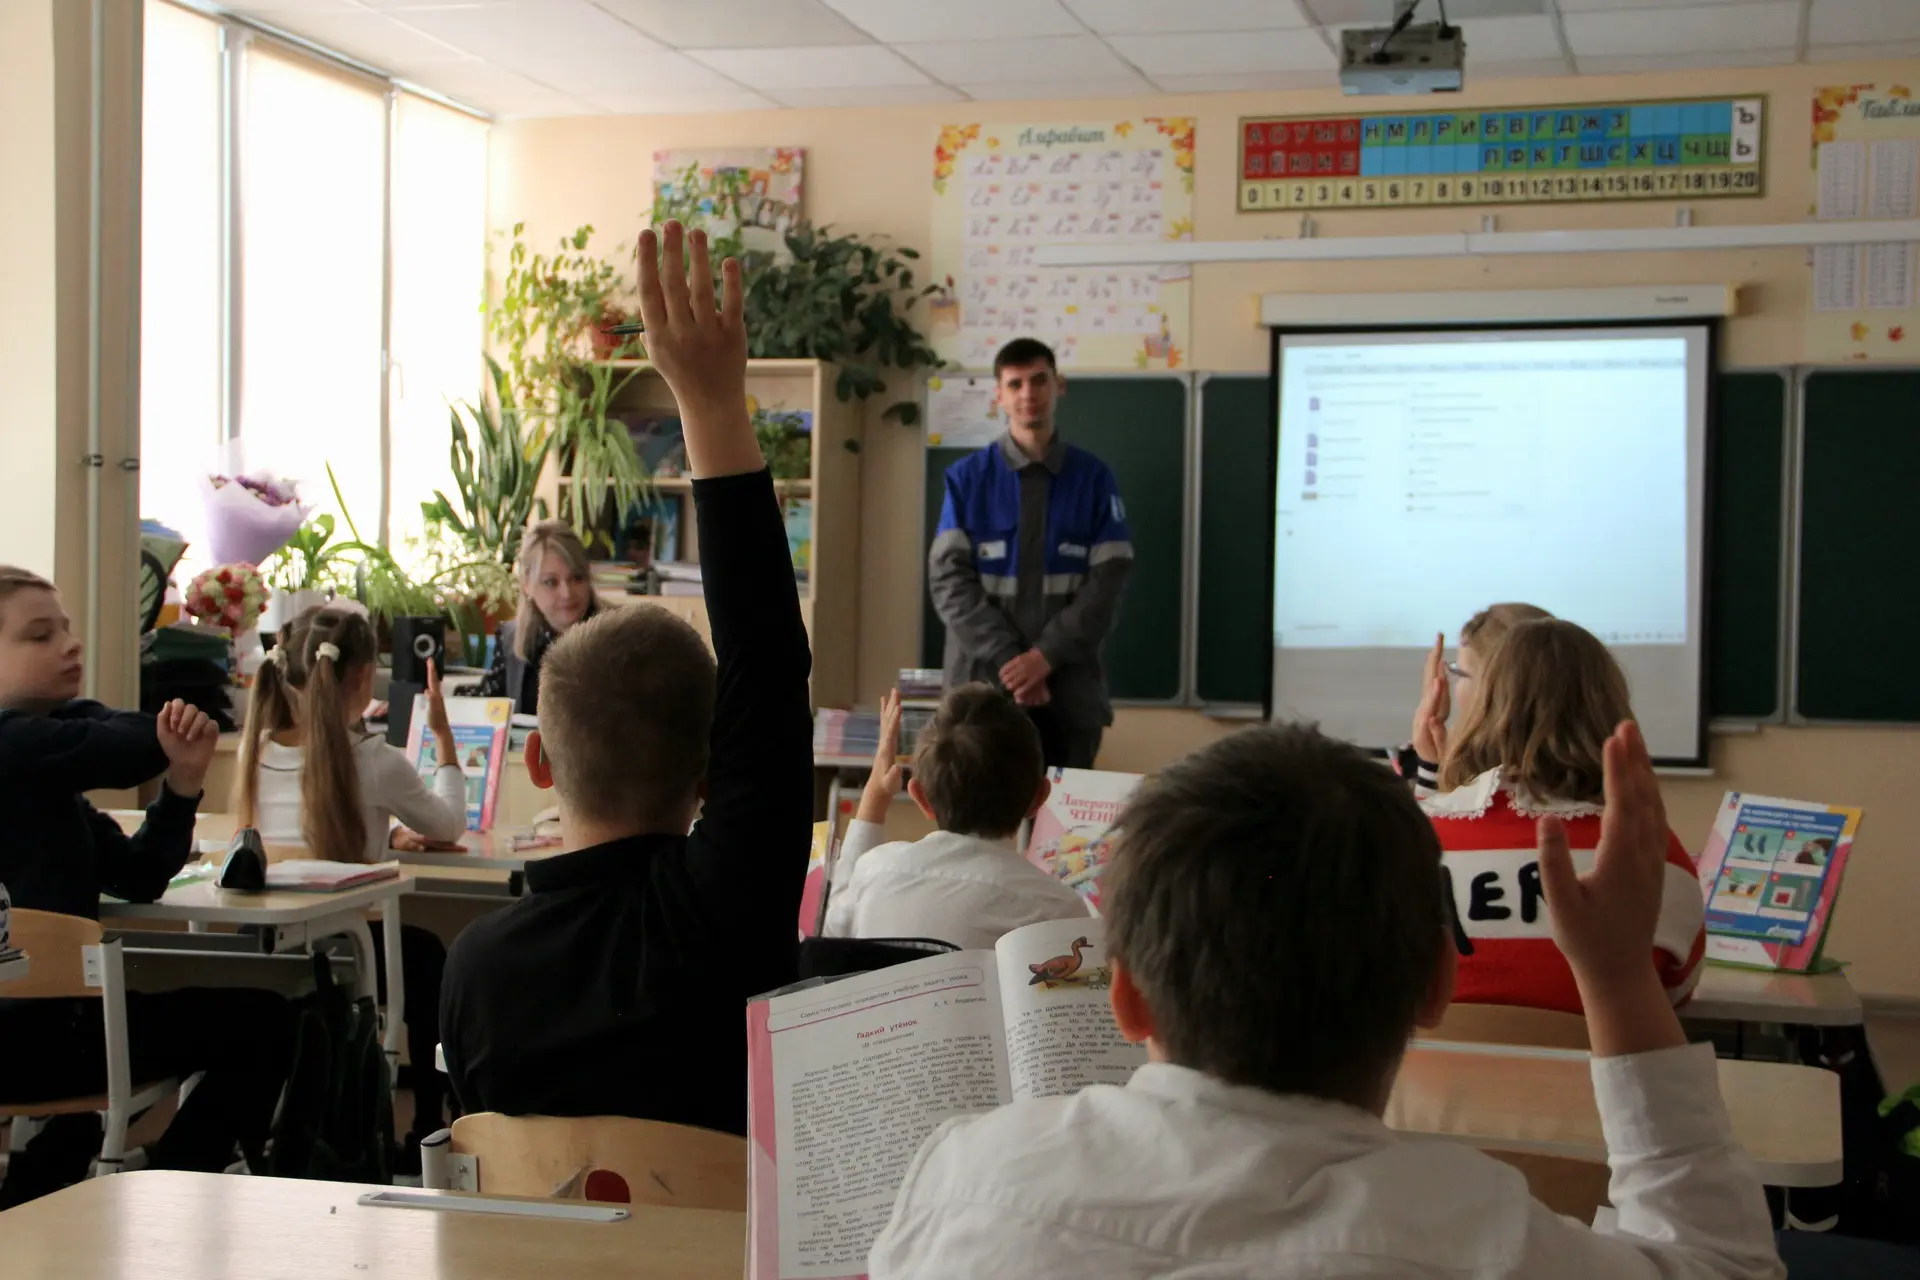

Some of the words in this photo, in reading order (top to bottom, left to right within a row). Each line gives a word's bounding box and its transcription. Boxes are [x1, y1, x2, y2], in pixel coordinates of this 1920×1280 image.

[1364, 124, 1379, 139] Н
[1388, 122, 1404, 137] М
[1437, 121, 1451, 136] Р
[1485, 118, 1499, 134] Б
[1510, 118, 1523, 133] В
[1535, 116, 1548, 132] Г
[1558, 115, 1574, 133] Д
[1581, 115, 1599, 129] Ж
[1610, 113, 1622, 128] З
[1735, 106, 1755, 124] Ъ
[1017, 126, 1105, 148] Алфавит
[1484, 148, 1499, 164] П
[1509, 148, 1524, 163] Ф
[1534, 147, 1547, 162] К
[1560, 145, 1572, 160] Т
[1579, 144, 1602, 161] Ш
[1608, 145, 1621, 160] С
[1634, 143, 1646, 159] Х
[1657, 141, 1673, 160] Ц
[1684, 141, 1700, 155] Ч
[1706, 139, 1729, 157] Щ
[1735, 138, 1751, 155] Ь
[1248, 188, 1258, 203] 0
[1273, 188, 1280, 201] 1
[1295, 187, 1304, 201] 2
[1318, 186, 1328, 201] 3
[1341, 185, 1351, 199] 4
[1364, 184, 1375, 199] 5
[1388, 184, 1399, 199] 6
[1413, 182, 1424, 197] 7
[1437, 182, 1448, 198] 8
[1461, 181, 1473, 197] 9
[1483, 180, 1504, 196] 10
[1509, 179, 1526, 195] 11
[1532, 178, 1552, 194] 12
[1557, 177, 1577, 193] 13
[1582, 177, 1600, 192] 14
[1607, 176, 1626, 191] 15
[1633, 175, 1654, 190] 16
[1659, 174, 1678, 189] 17
[1684, 173, 1705, 189] 18
[1709, 172, 1730, 188] 19
[1733, 171, 1757, 187] 20
[948, 974, 968, 983] урока
[856, 1025, 885, 1040] Гадкий
[889, 1019, 918, 1032] утёнок
